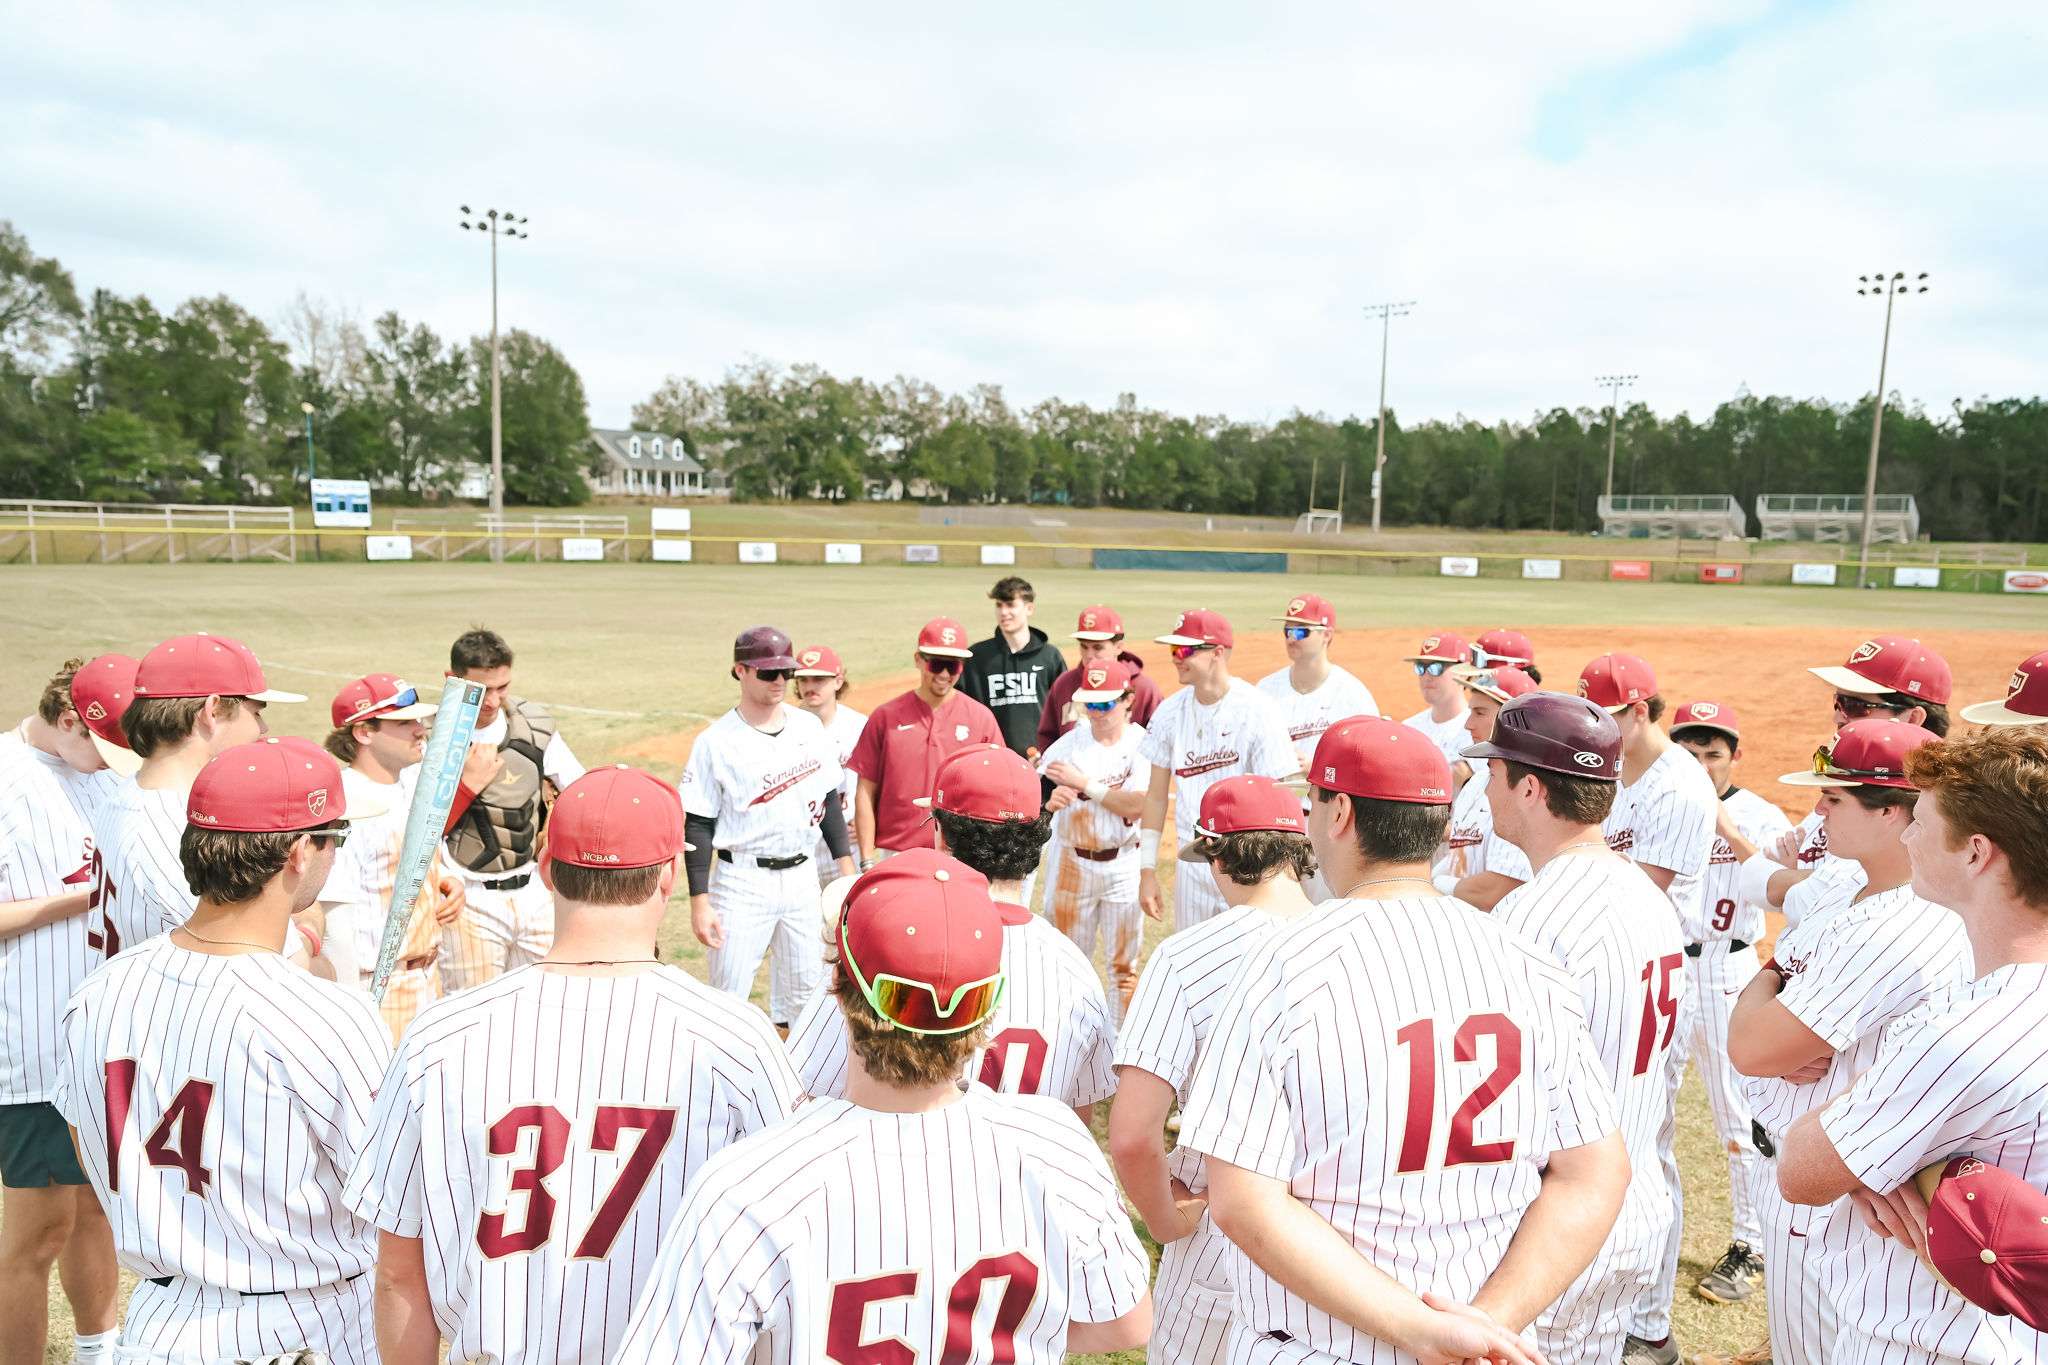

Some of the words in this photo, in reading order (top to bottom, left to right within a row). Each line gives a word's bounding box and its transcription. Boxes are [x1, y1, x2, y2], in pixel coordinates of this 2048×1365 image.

[988, 672, 1037, 698] FSU
[761, 757, 820, 790] Seminoles
[583, 851, 609, 863] NCBA
[1711, 898, 1736, 932] 9
[1632, 952, 1687, 1077] 15
[104, 1056, 217, 1202] 14
[1396, 1012, 1522, 1176] 12
[474, 1102, 680, 1262] 37
[826, 1250, 1040, 1365] 50
